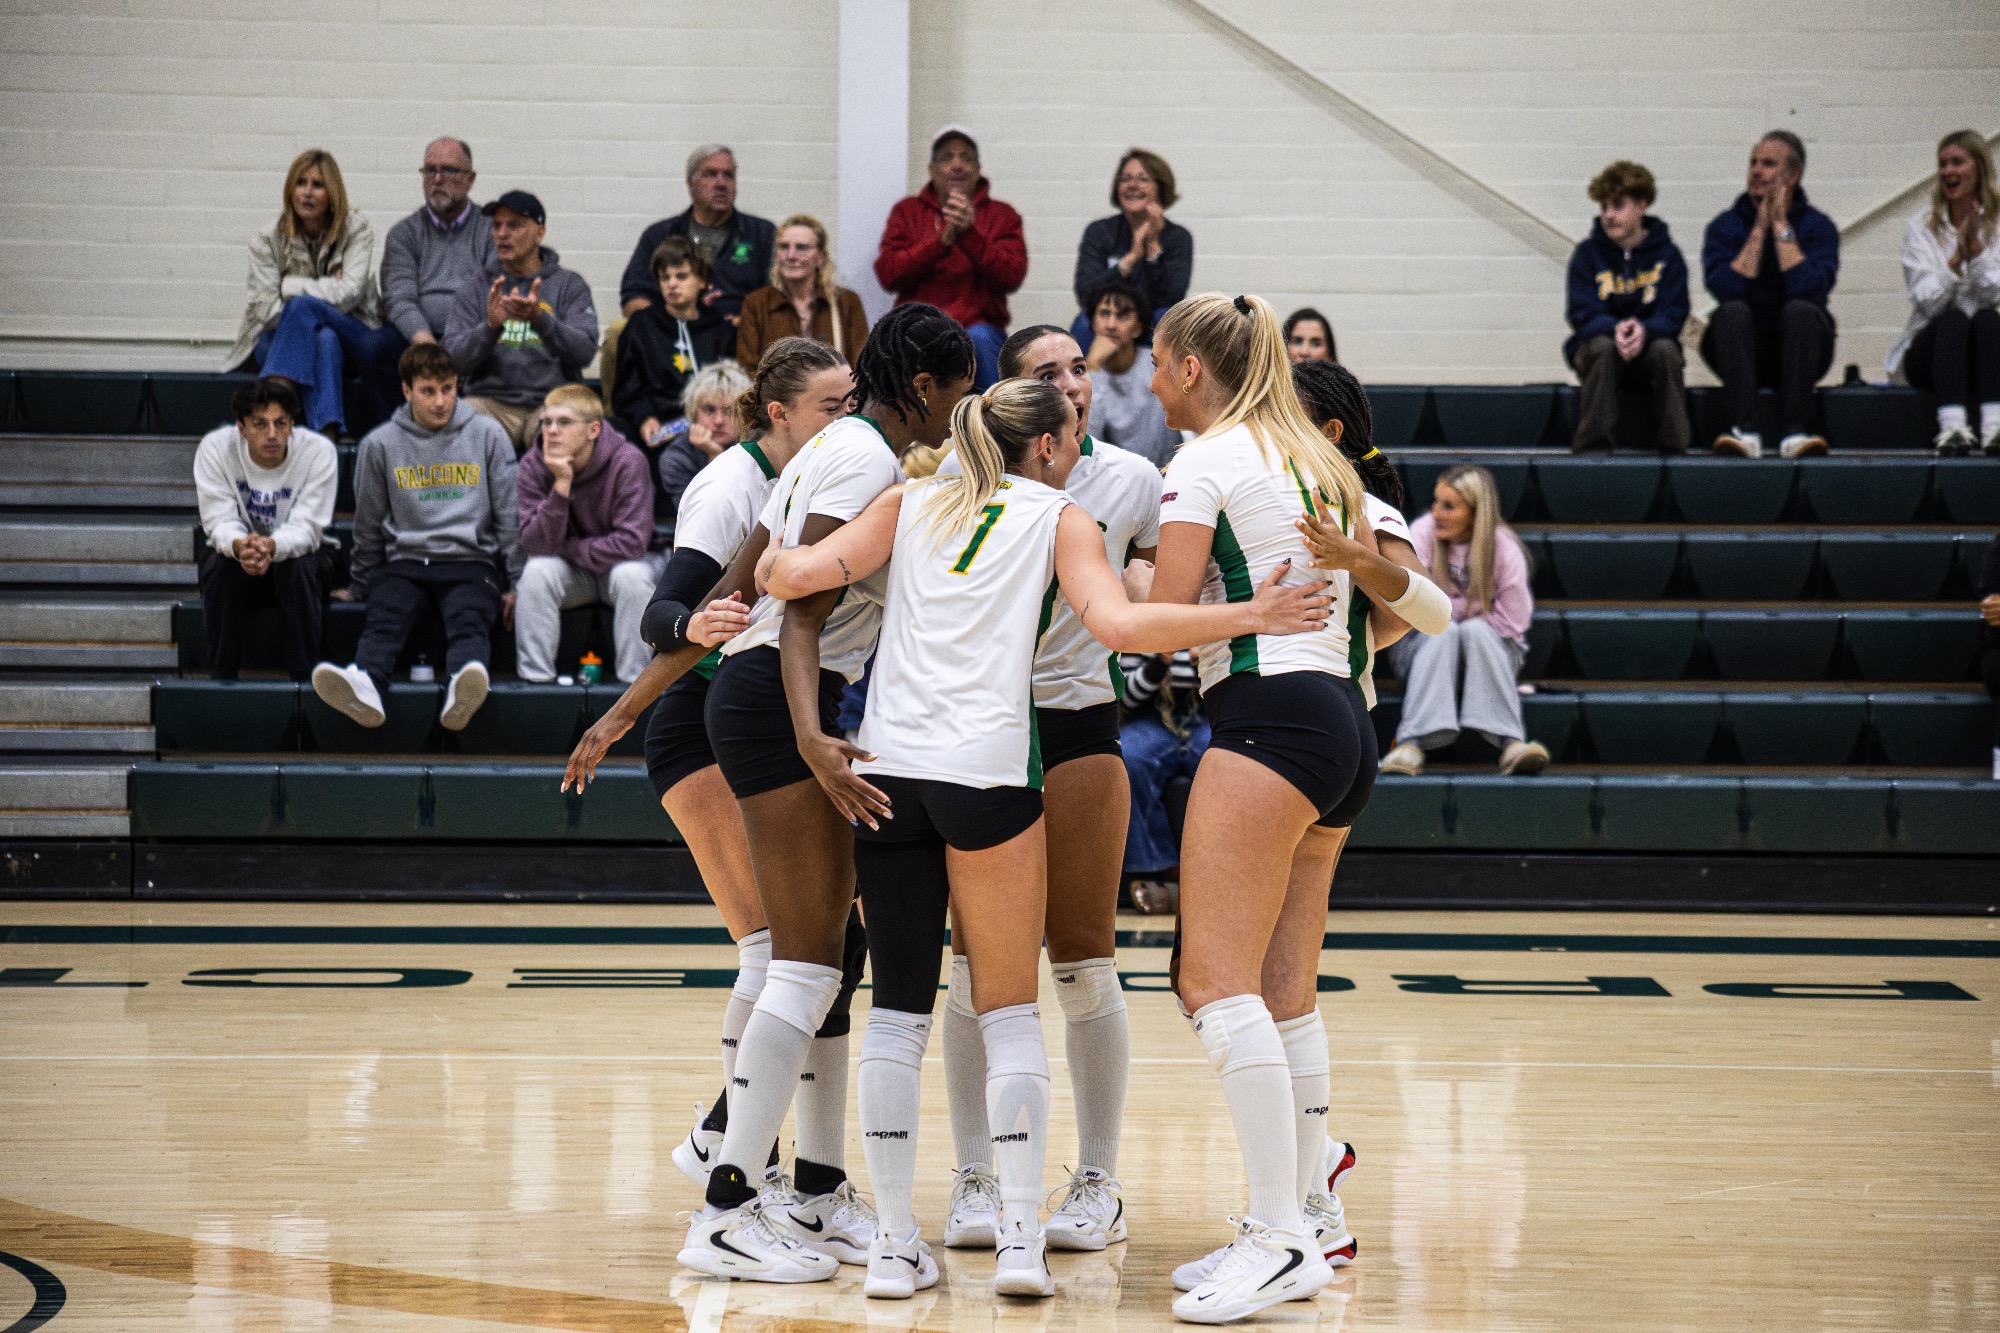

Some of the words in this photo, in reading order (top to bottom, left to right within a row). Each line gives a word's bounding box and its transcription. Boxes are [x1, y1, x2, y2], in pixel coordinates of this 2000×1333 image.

[394, 463, 480, 489] FALCONS
[948, 502, 1007, 575] 7
[865, 1130, 908, 1140] capelli
[991, 1132, 1028, 1143] capelli
[765, 1170, 778, 1181] NIKE
[1084, 1169, 1101, 1179] NIKE
